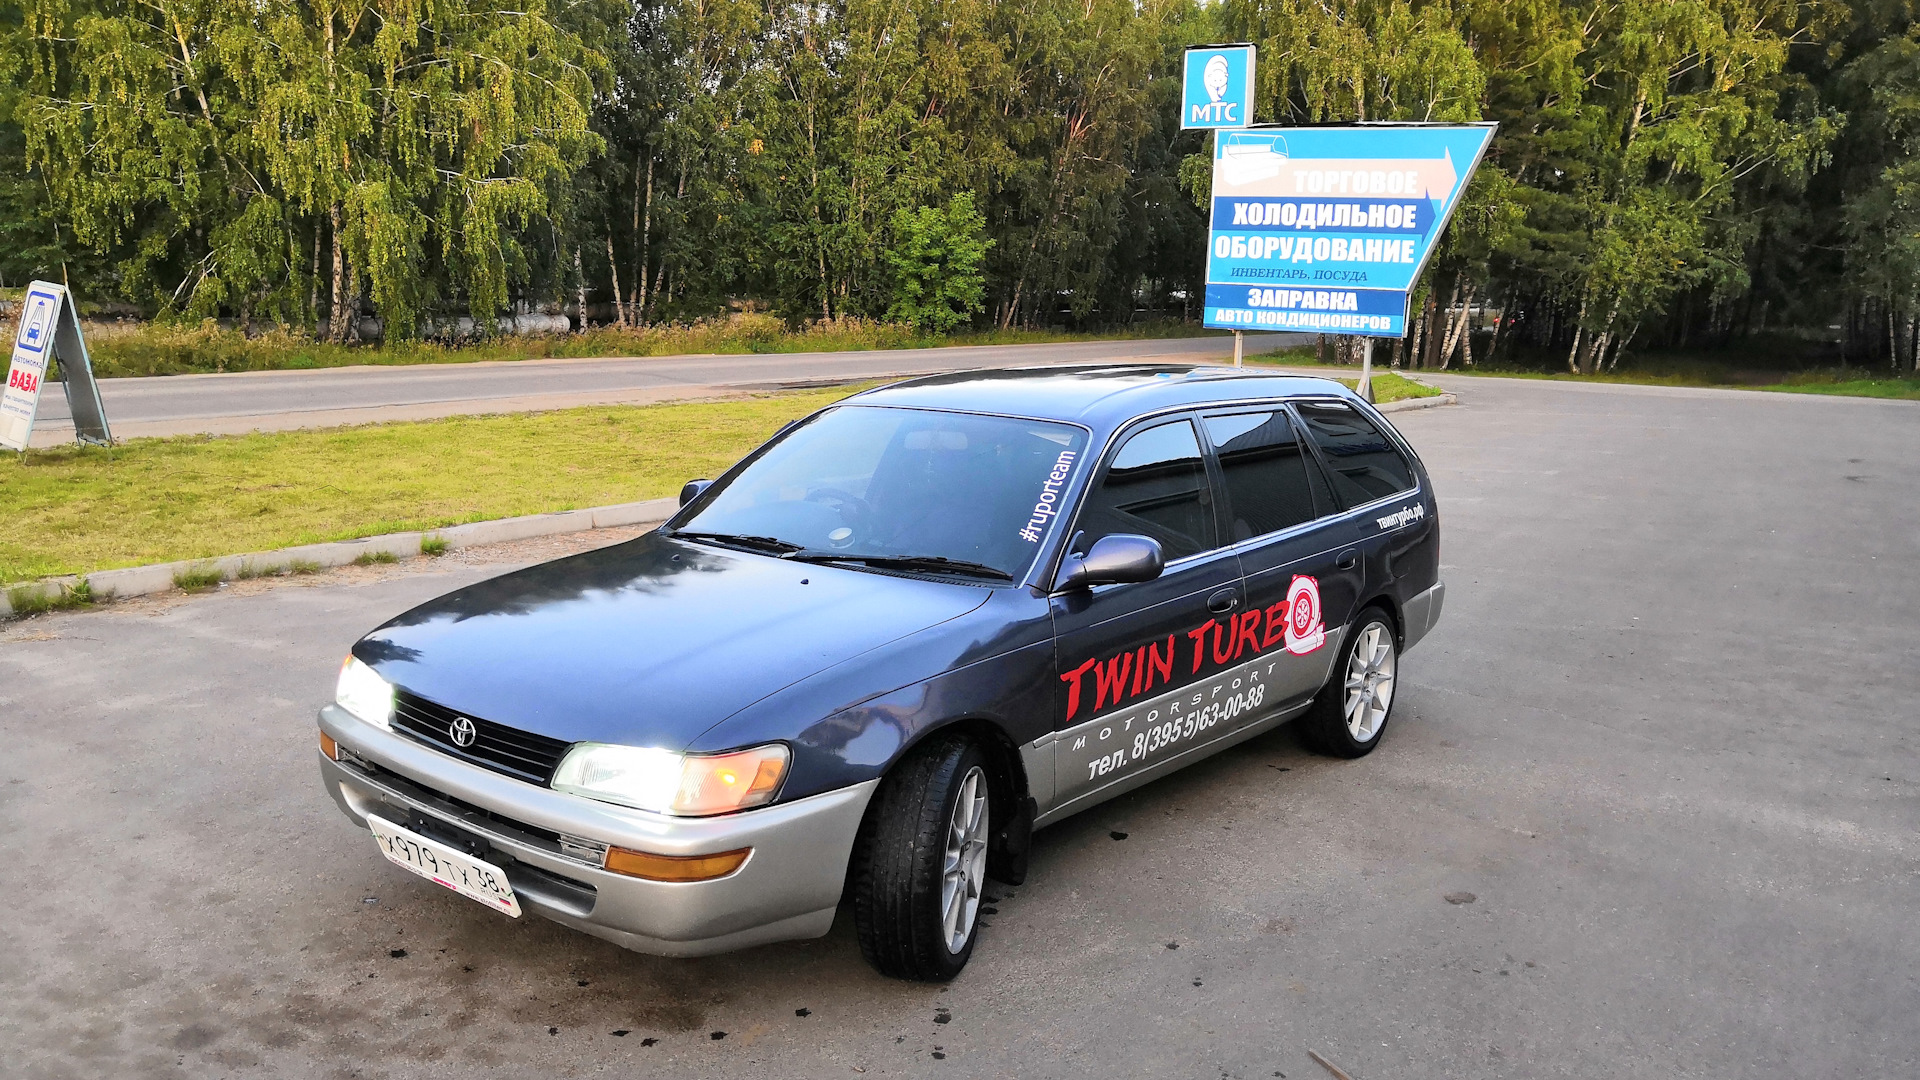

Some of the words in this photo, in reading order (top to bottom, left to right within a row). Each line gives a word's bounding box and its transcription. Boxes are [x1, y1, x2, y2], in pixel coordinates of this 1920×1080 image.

[1191, 101, 1238, 123] МТС
[1293, 170, 1418, 194] ТОРГОВОЕ
[1232, 202, 1417, 229] ХОЛОДИЛЬНОЕ
[1214, 235, 1415, 264] ОБОРУДОВАНИЕ
[1230, 267, 1310, 281] ИНВЕНТАРЬ,
[1313, 269, 1368, 282] ПОСУДА
[1247, 288, 1358, 311] ЗАПРАВКА
[1215, 309, 1253, 324] АВТО
[1256, 311, 1391, 330] КОНДИЦИОНЕРОВ
[9, 369, 38, 394] БАЗА
[1019, 450, 1076, 543] #ruporteam
[1376, 502, 1424, 529] твинтурбо.рф
[1060, 634, 1175, 721] TWIN
[1072, 663, 1276, 751] MOTORSPORT
[1088, 749, 1127, 781] тел.
[471, 866, 499, 893] 38
